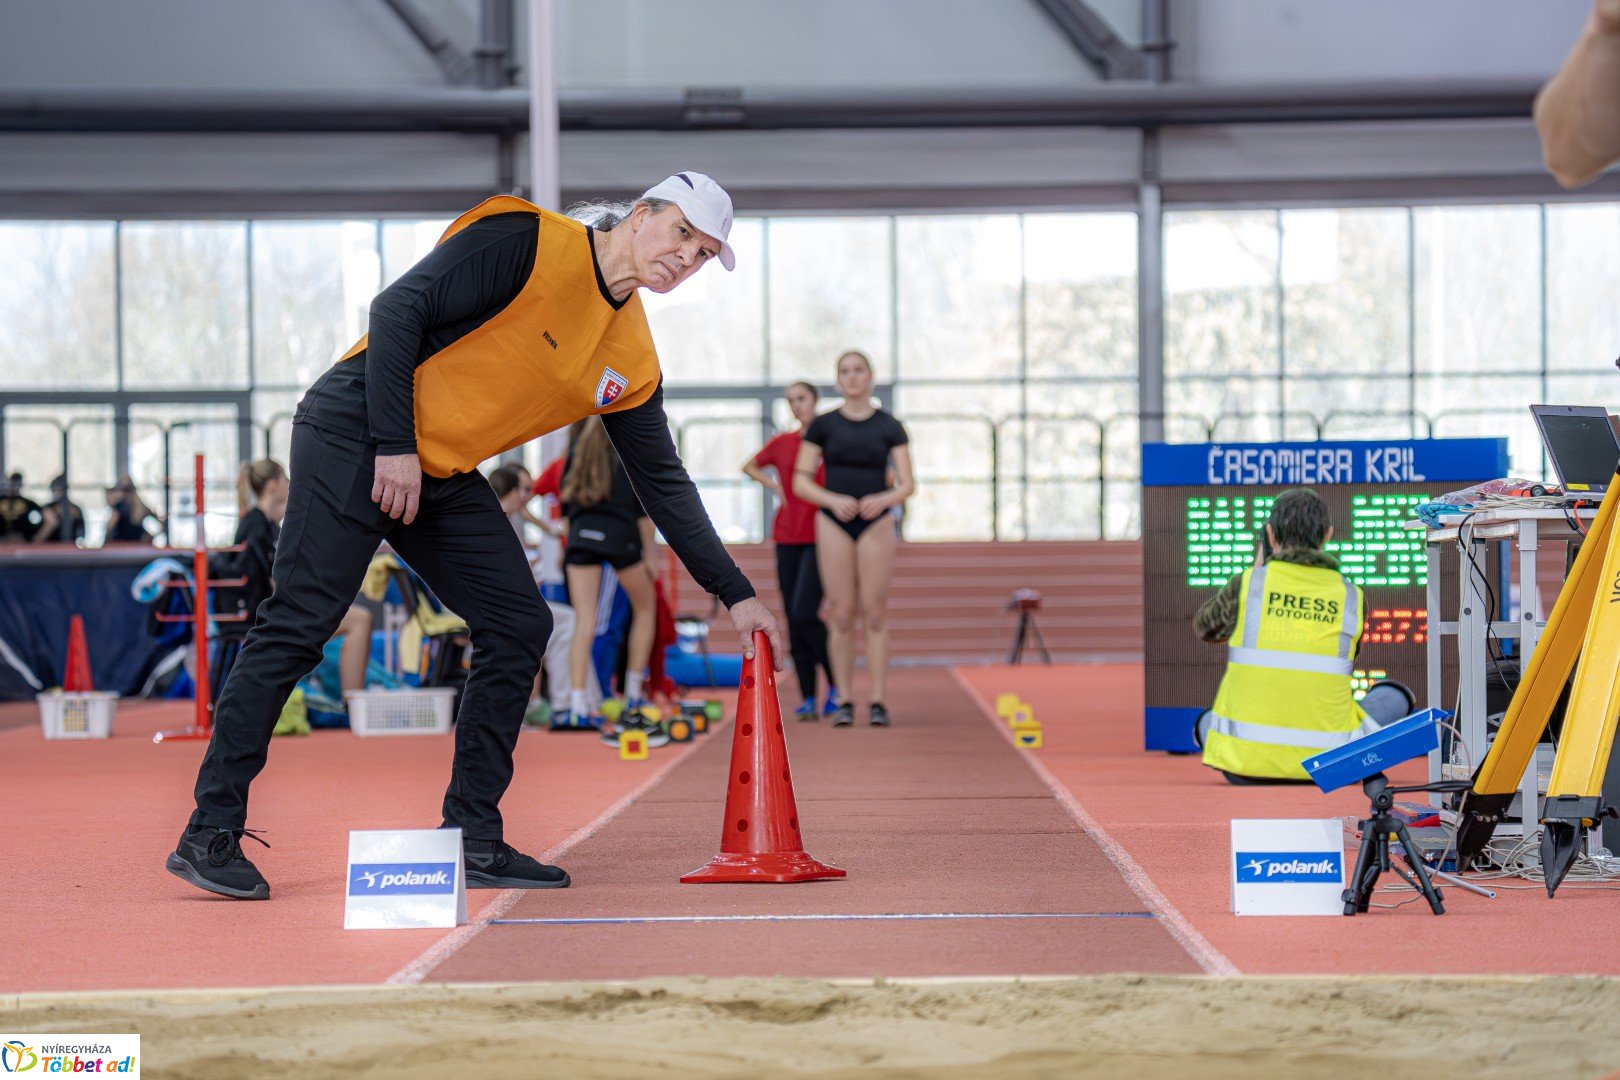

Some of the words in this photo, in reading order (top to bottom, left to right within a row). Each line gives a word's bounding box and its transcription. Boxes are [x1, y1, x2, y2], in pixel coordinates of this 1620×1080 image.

[1208, 445, 1352, 485] ČASOMIERA
[1365, 447, 1426, 483] KRIL
[1269, 592, 1338, 615] PRESS
[1267, 607, 1337, 624] FOTOGRAF
[1267, 859, 1335, 877] polanik
[380, 870, 449, 889] polanik
